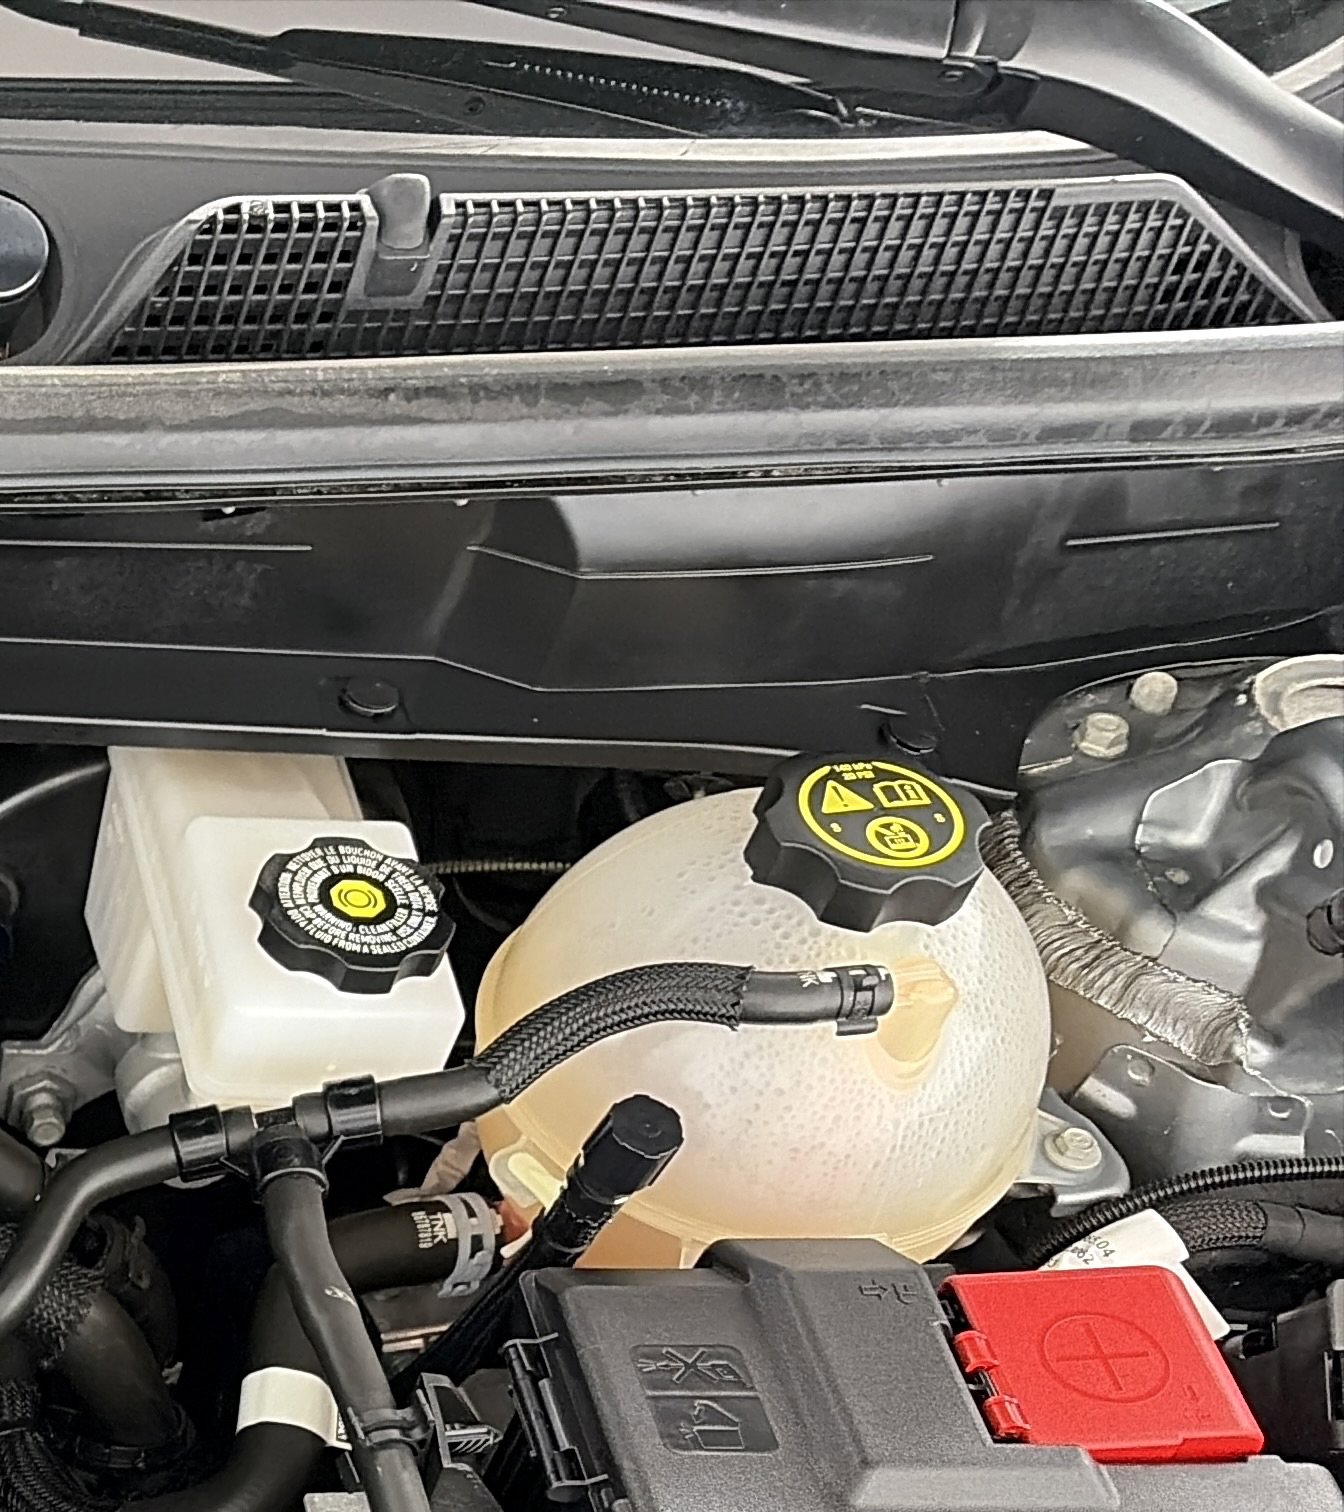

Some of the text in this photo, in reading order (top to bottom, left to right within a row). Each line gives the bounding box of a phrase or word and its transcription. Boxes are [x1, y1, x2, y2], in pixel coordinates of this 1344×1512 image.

[338, 844, 384, 862] BOUCHON
[332, 937, 362, 953] FROM
[429, 1211, 448, 1244] TNK
